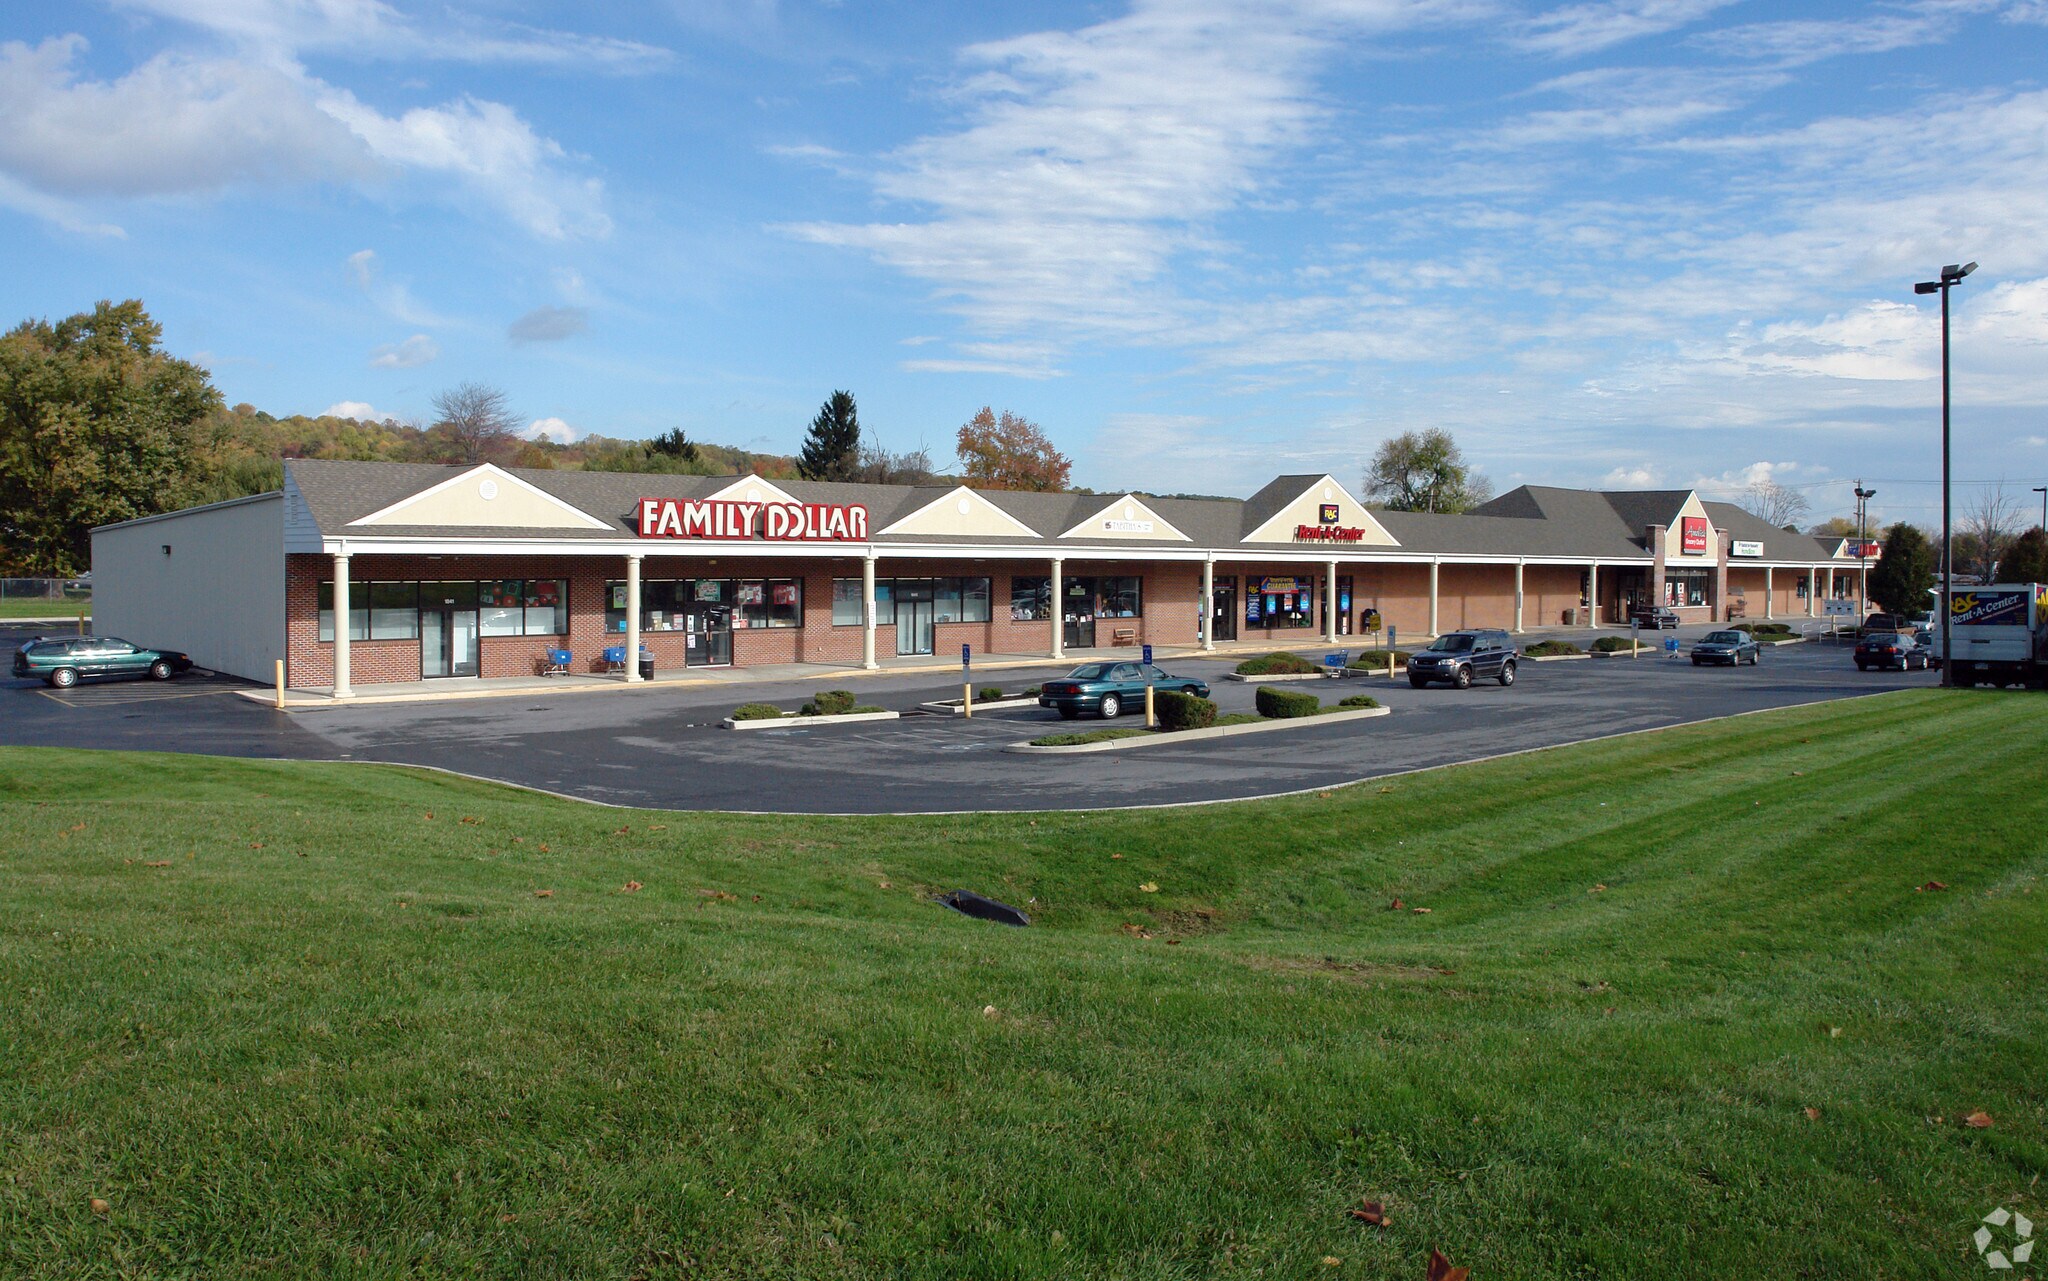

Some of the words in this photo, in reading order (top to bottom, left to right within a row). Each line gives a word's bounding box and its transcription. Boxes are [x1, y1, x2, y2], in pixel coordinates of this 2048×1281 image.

[642, 500, 761, 538] FAMILY
[767, 505, 867, 539] DOLLAR
[1324, 509, 1338, 520] RAC
